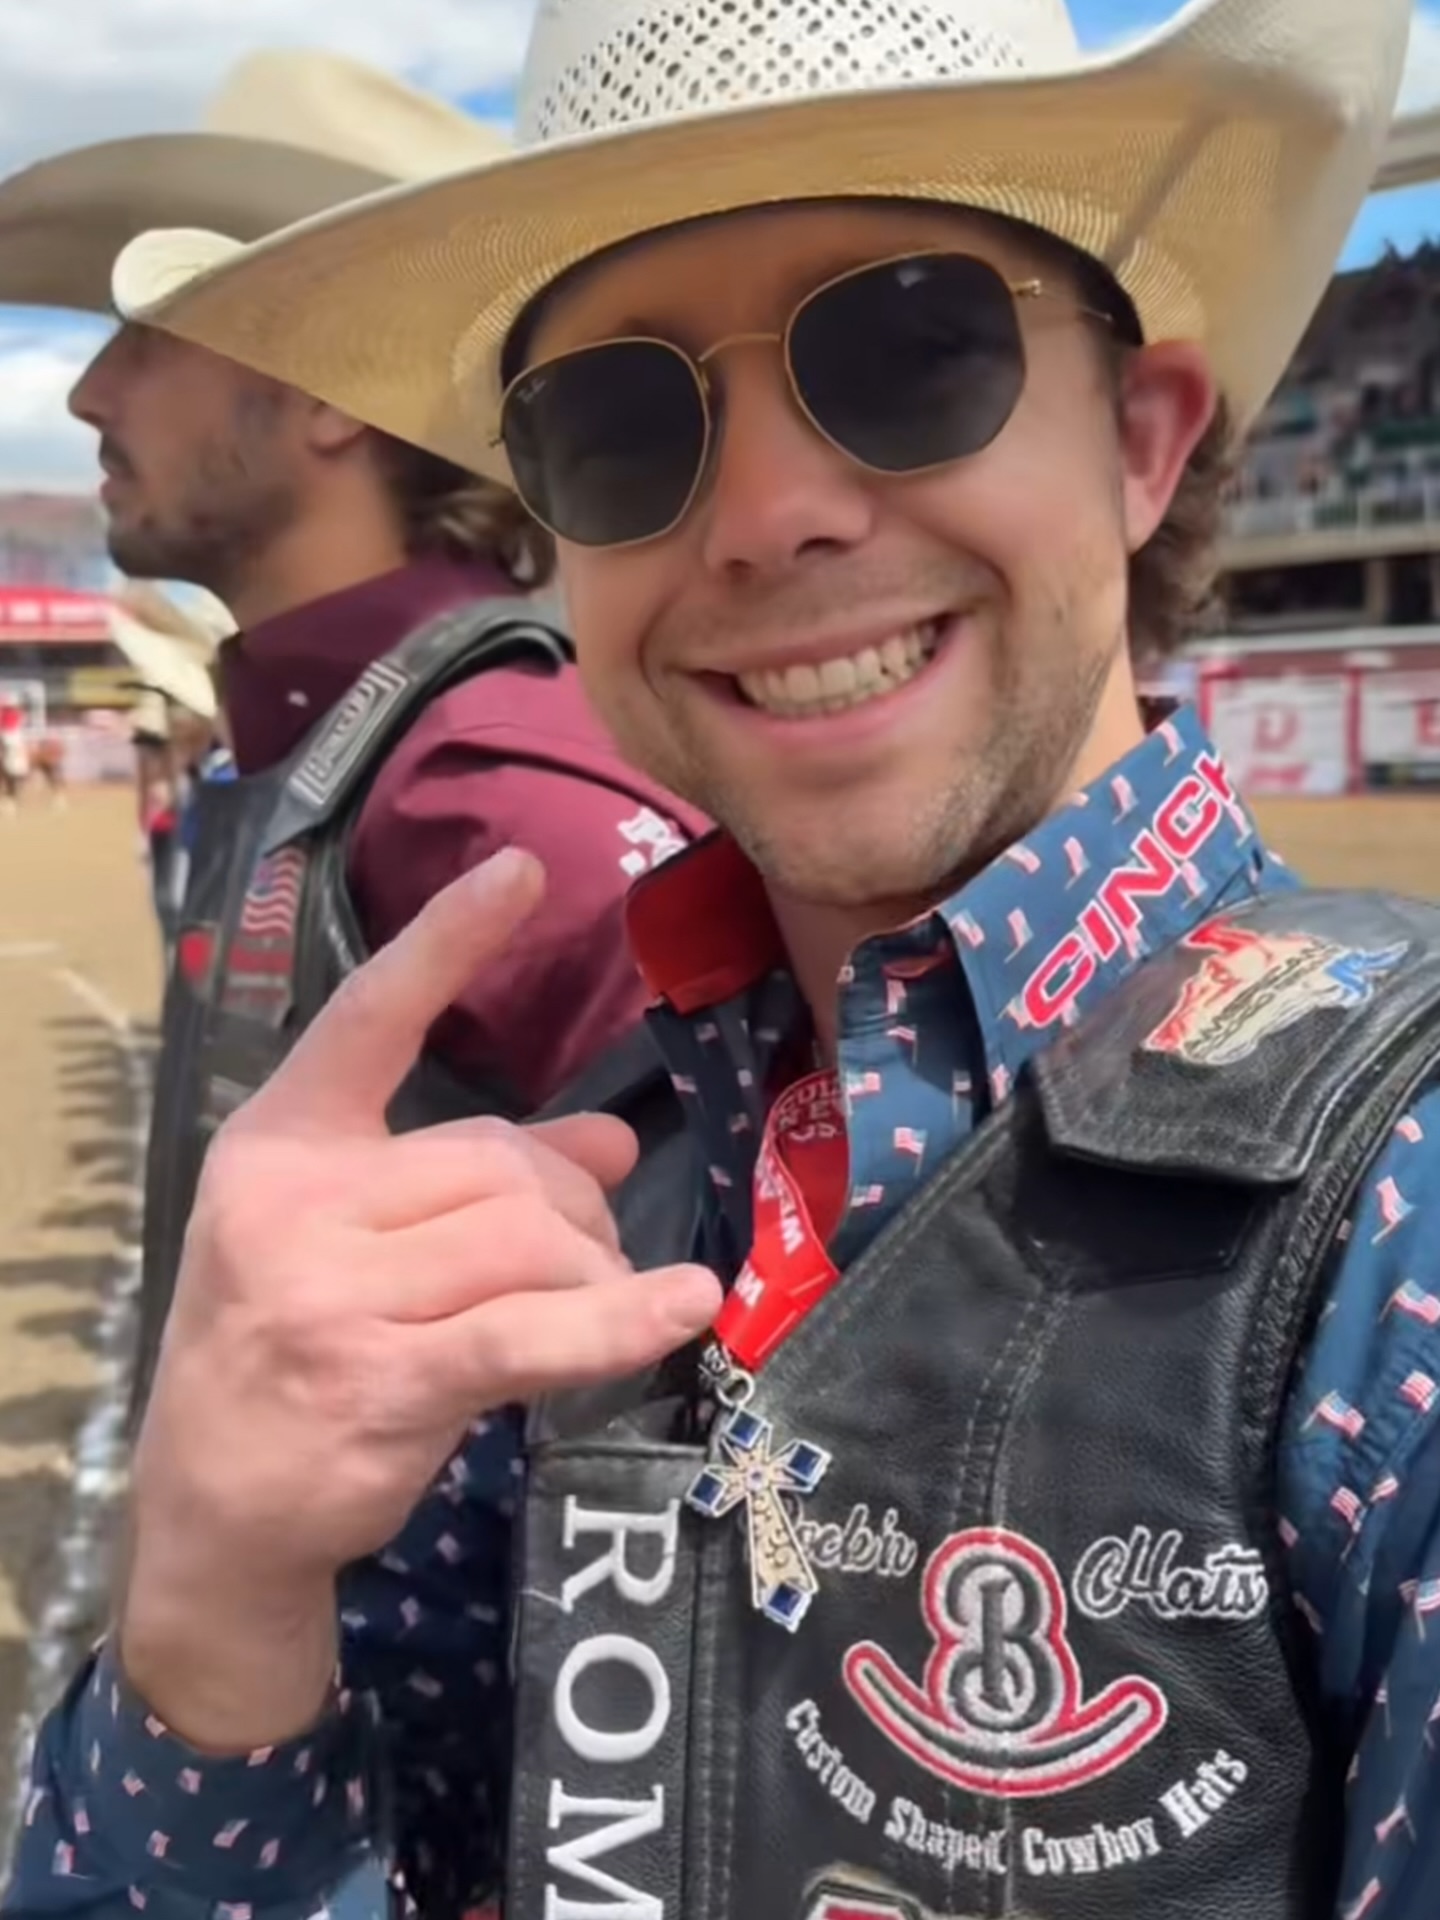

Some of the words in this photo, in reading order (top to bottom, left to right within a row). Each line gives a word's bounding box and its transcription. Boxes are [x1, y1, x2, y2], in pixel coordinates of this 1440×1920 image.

[1072, 1525, 1269, 1619] Hats
[786, 1699, 876, 1824] Custom
[884, 1796, 1007, 1875] Shaped
[1022, 1817, 1162, 1876] Cowboy
[1158, 1749, 1248, 1838] Hats
